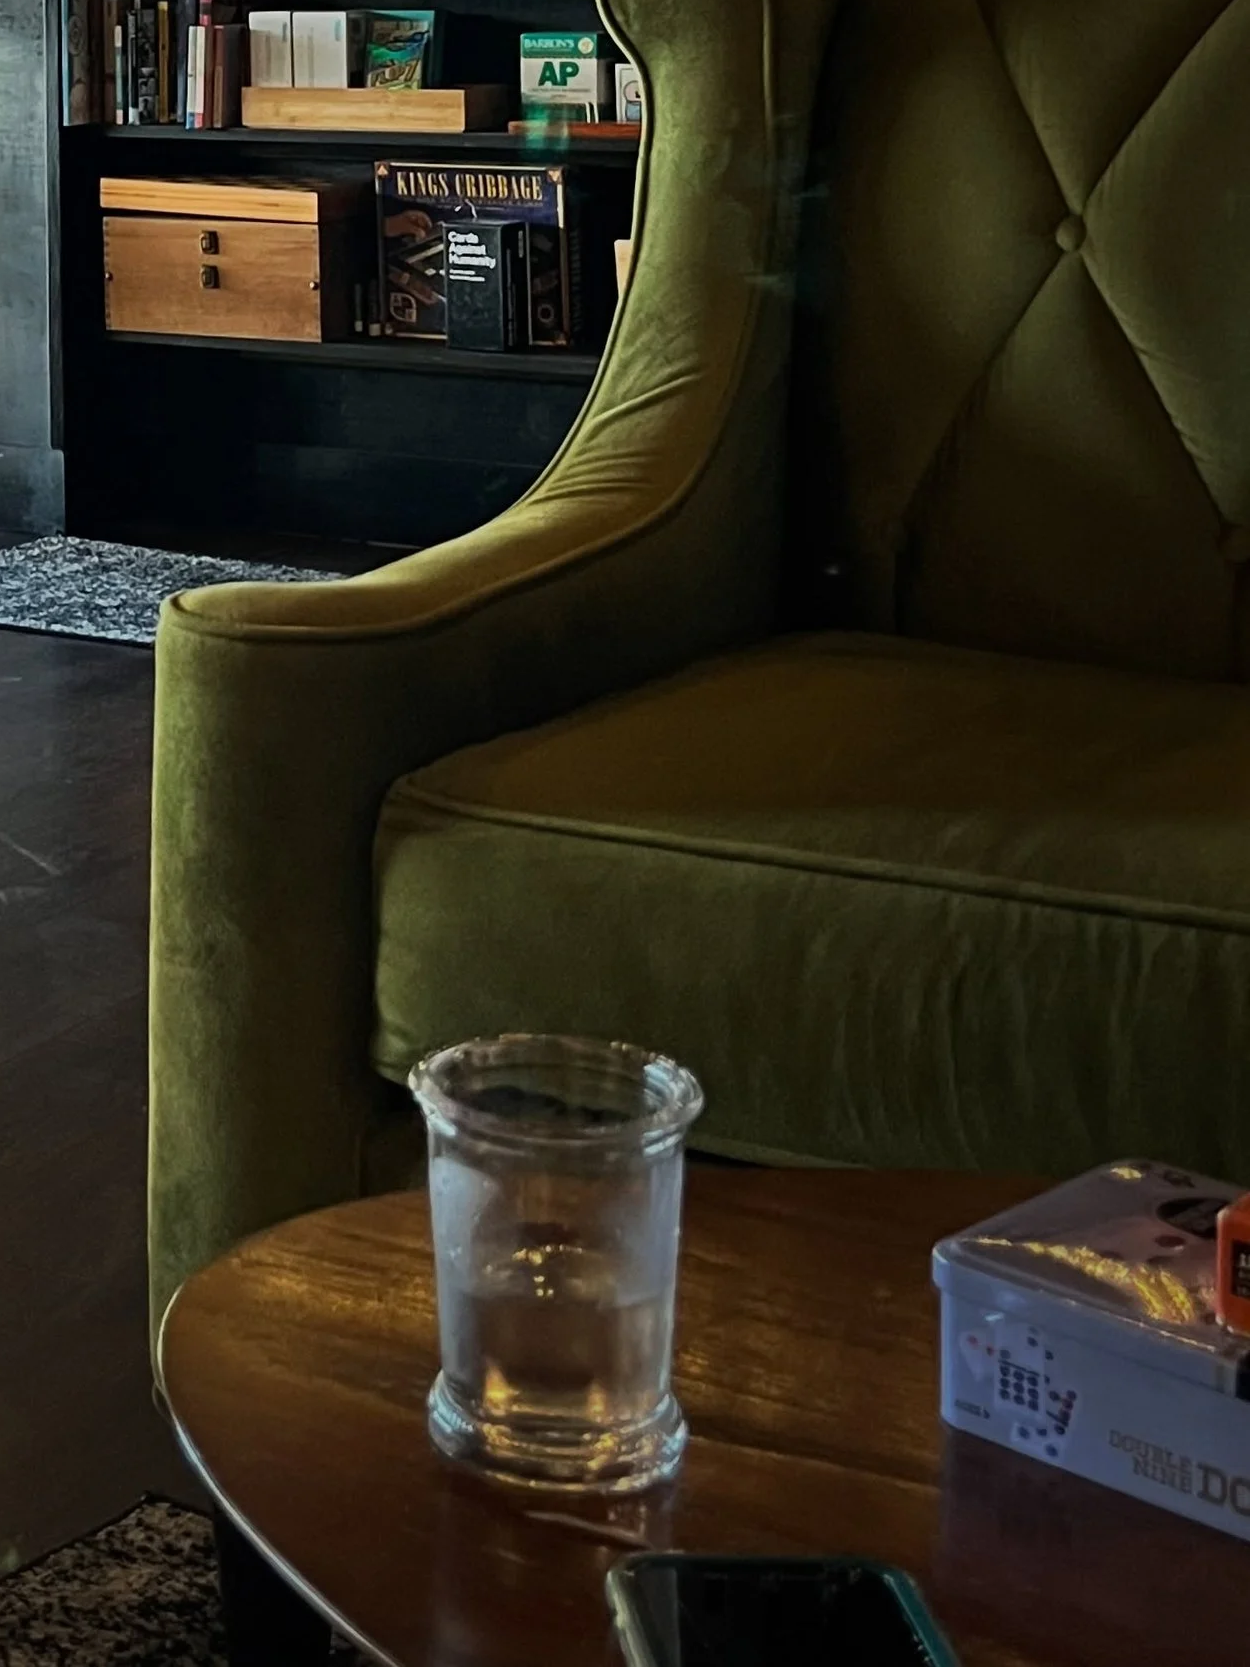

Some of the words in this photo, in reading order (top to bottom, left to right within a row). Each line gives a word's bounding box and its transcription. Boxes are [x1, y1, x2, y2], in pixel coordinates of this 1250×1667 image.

[524, 38, 575, 49] BARRON'S
[538, 61, 579, 86] AP
[396, 171, 450, 197] KINGS
[454, 173, 543, 201] CRIBBAGE
[1108, 1429, 1193, 1471] DOUBLE
[1132, 1455, 1193, 1494] NINE
